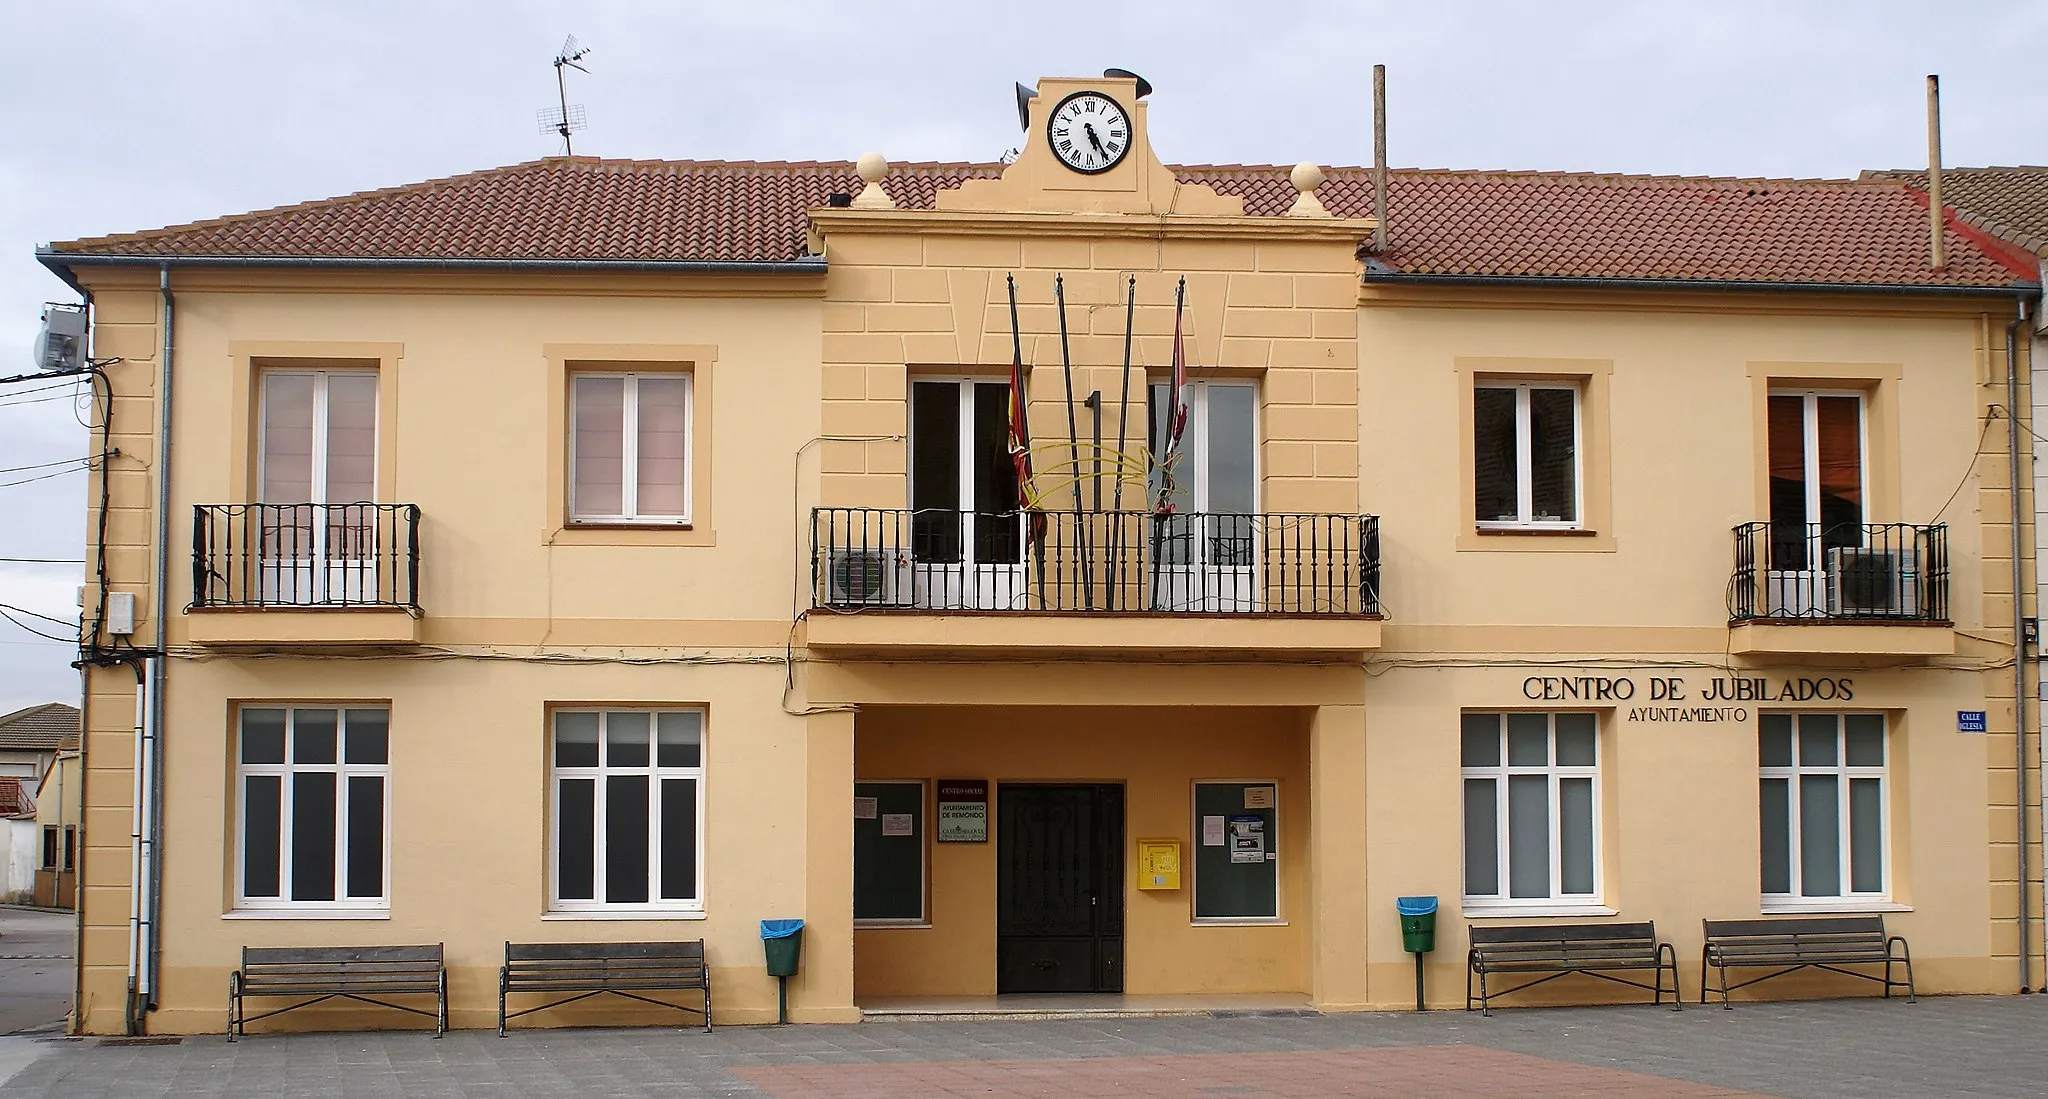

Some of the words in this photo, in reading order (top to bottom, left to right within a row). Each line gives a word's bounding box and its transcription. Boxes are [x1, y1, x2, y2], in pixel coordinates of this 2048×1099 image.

[1070, 104, 1081, 116] XI
[1085, 101, 1095, 112] XII
[1100, 106, 1106, 115] I
[1061, 114, 1072, 124] X
[1107, 116, 1118, 125] II
[1057, 128, 1068, 136] IX
[1060, 140, 1072, 154] VIII
[1070, 150, 1082, 162] VII
[1086, 154, 1094, 165] VI
[1523, 677, 1634, 700] CENTRO
[1650, 677, 1686, 700] DE
[1701, 677, 1853, 701] JUBILADOS
[1628, 708, 1747, 722] AYUNTAMIENTO
